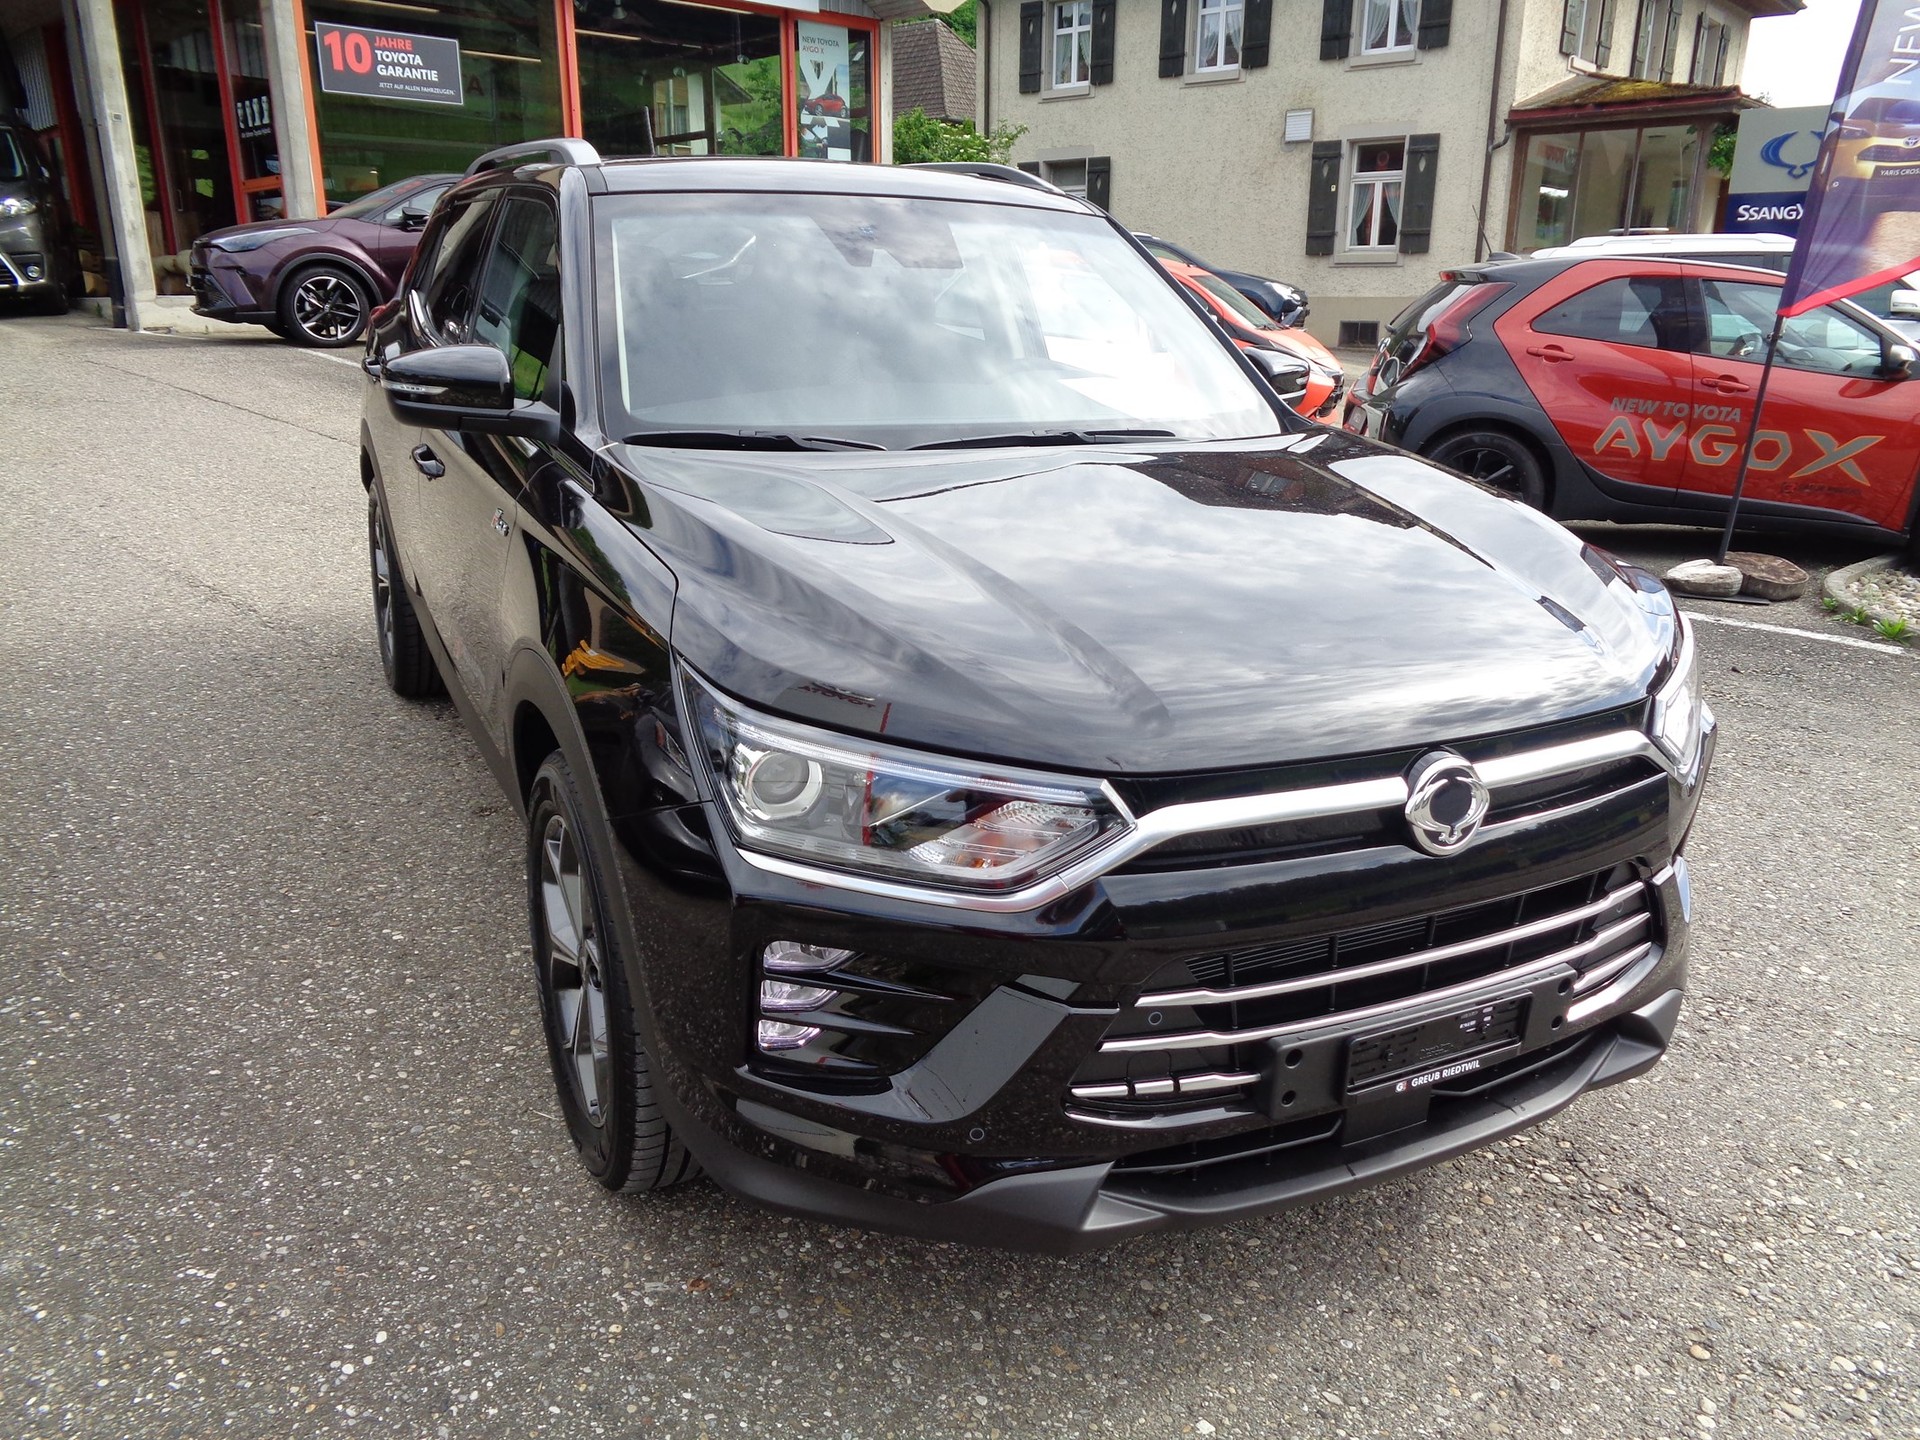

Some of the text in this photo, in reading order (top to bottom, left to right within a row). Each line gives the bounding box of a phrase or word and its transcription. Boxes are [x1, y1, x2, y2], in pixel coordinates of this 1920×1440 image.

[374, 36, 413, 51] JAHRE
[802, 36, 840, 47] NEW TOYOTA
[802, 45, 819, 54] AYGO
[324, 31, 372, 73] 10
[375, 50, 424, 67] TOYOTA
[376, 64, 439, 82] GARANTIE
[1900, 168, 1920, 176] CROS
[1609, 397, 1742, 422] NEW TOYOTA
[1593, 415, 1887, 487] AYGO X
[1411, 1072, 1440, 1087] GREUB
[1442, 1060, 1480, 1078] RIEDTWIL
